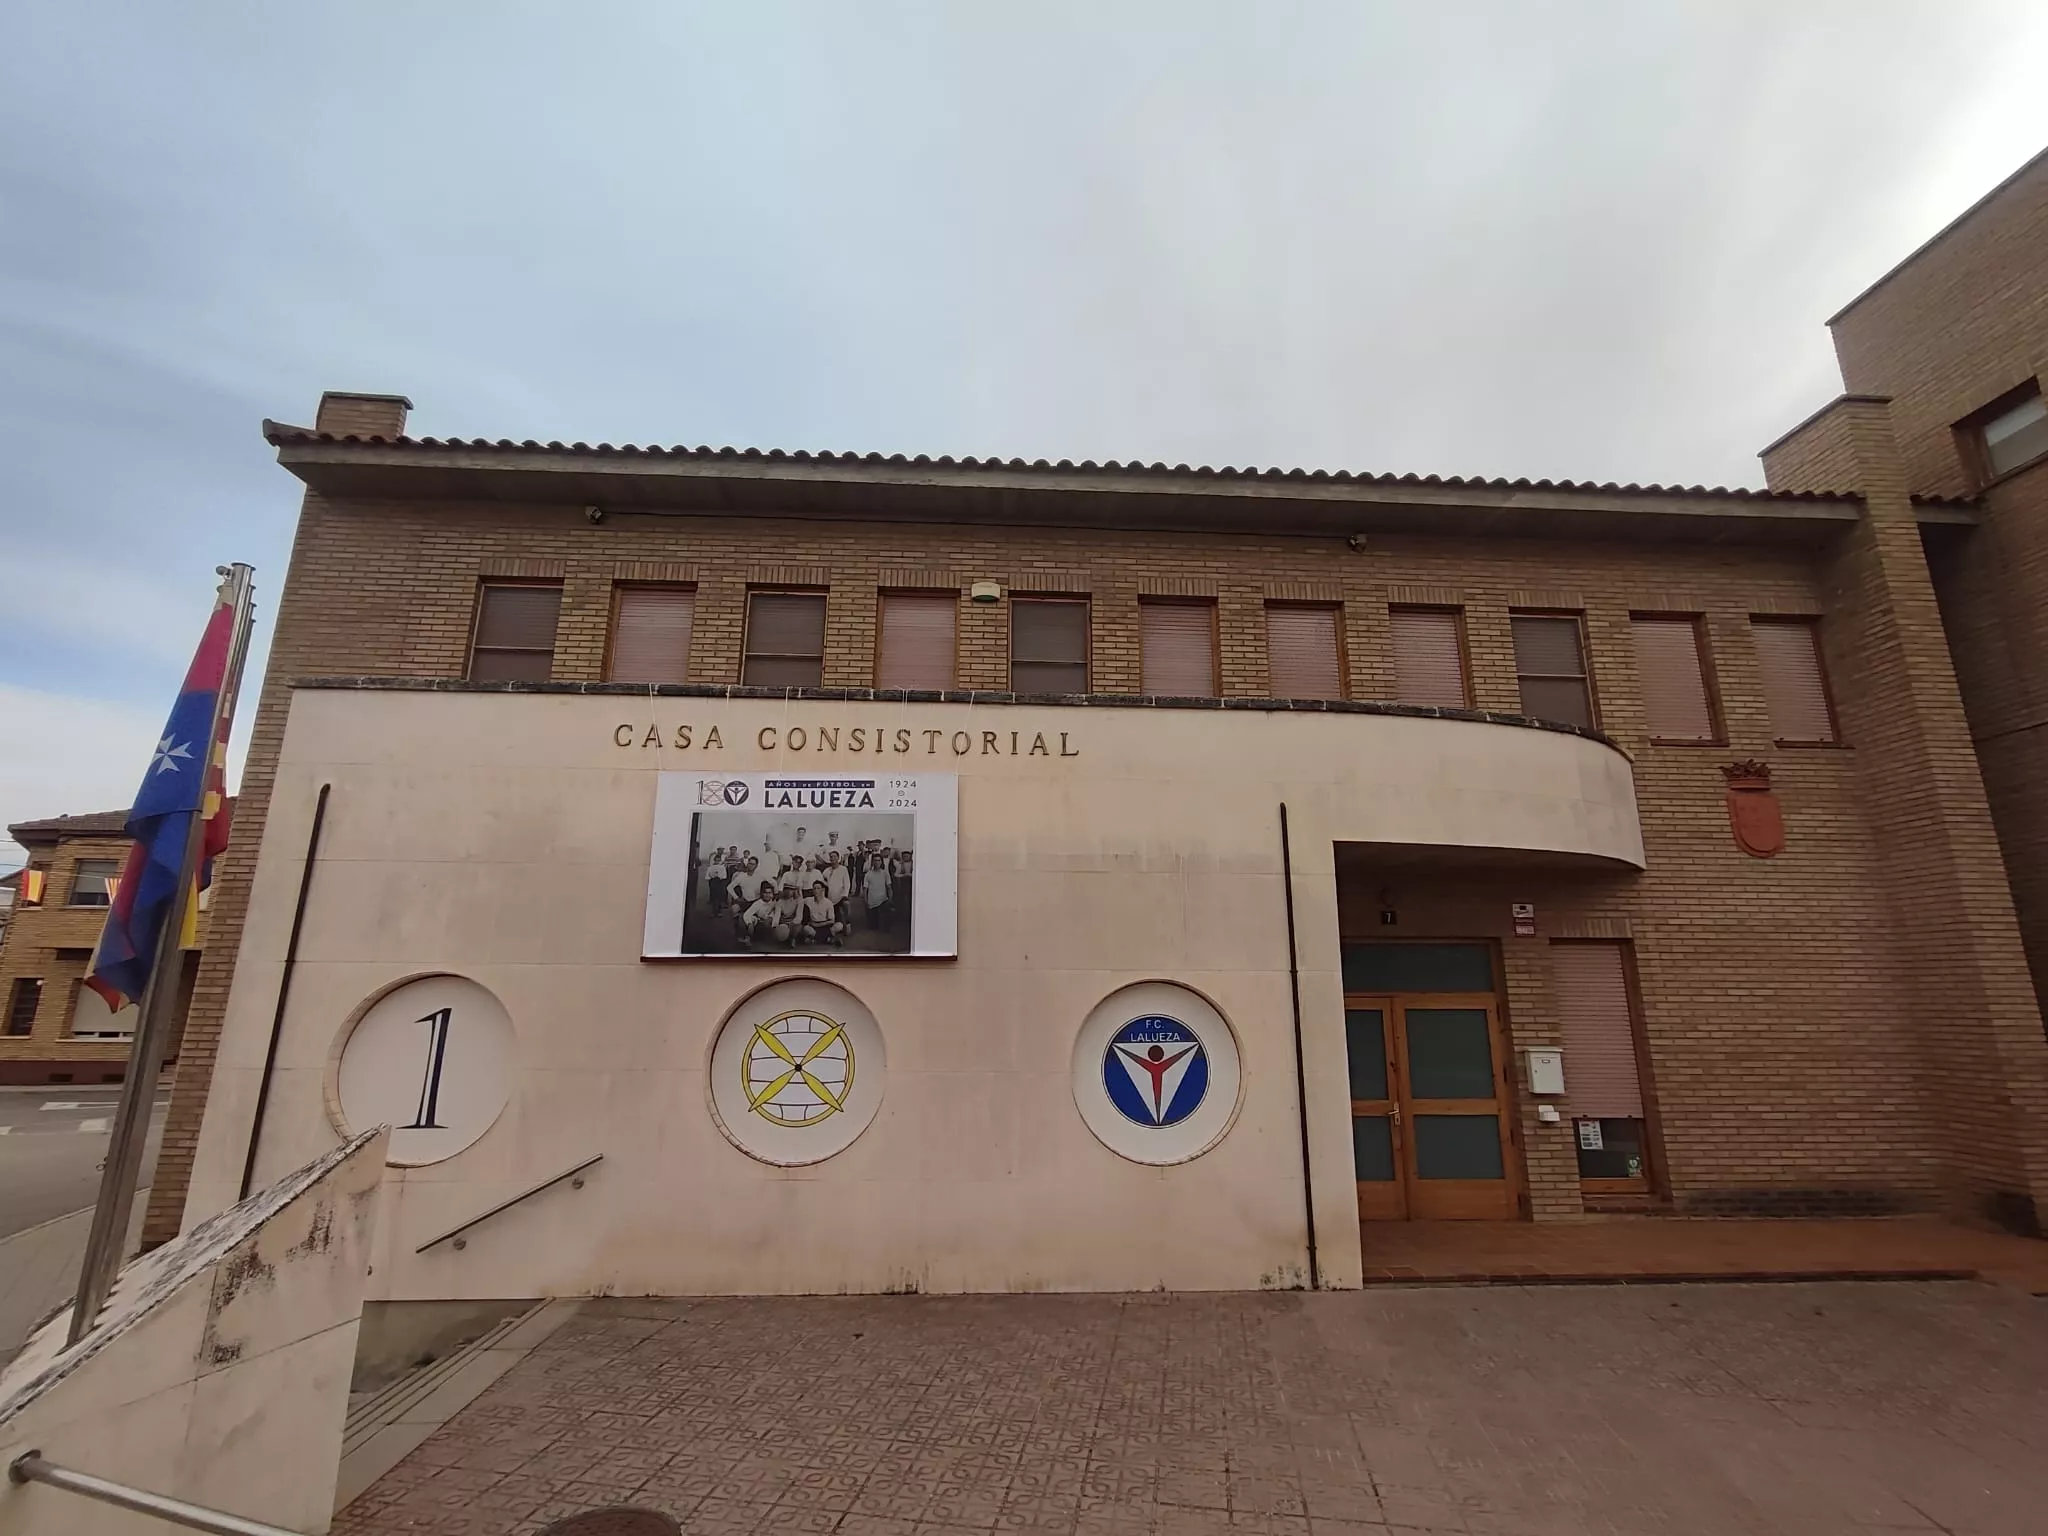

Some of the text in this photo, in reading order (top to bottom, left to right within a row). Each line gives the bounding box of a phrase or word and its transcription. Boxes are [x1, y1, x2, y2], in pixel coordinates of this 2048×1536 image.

[613, 723, 1080, 756] CASA CONSISTORIAL
[889, 780, 917, 788] 1924
[765, 790, 875, 808] LALUEZA
[889, 799, 917, 808] 2024
[1130, 1032, 1181, 1042] LALUEZA
[396, 1007, 453, 1129] 1
